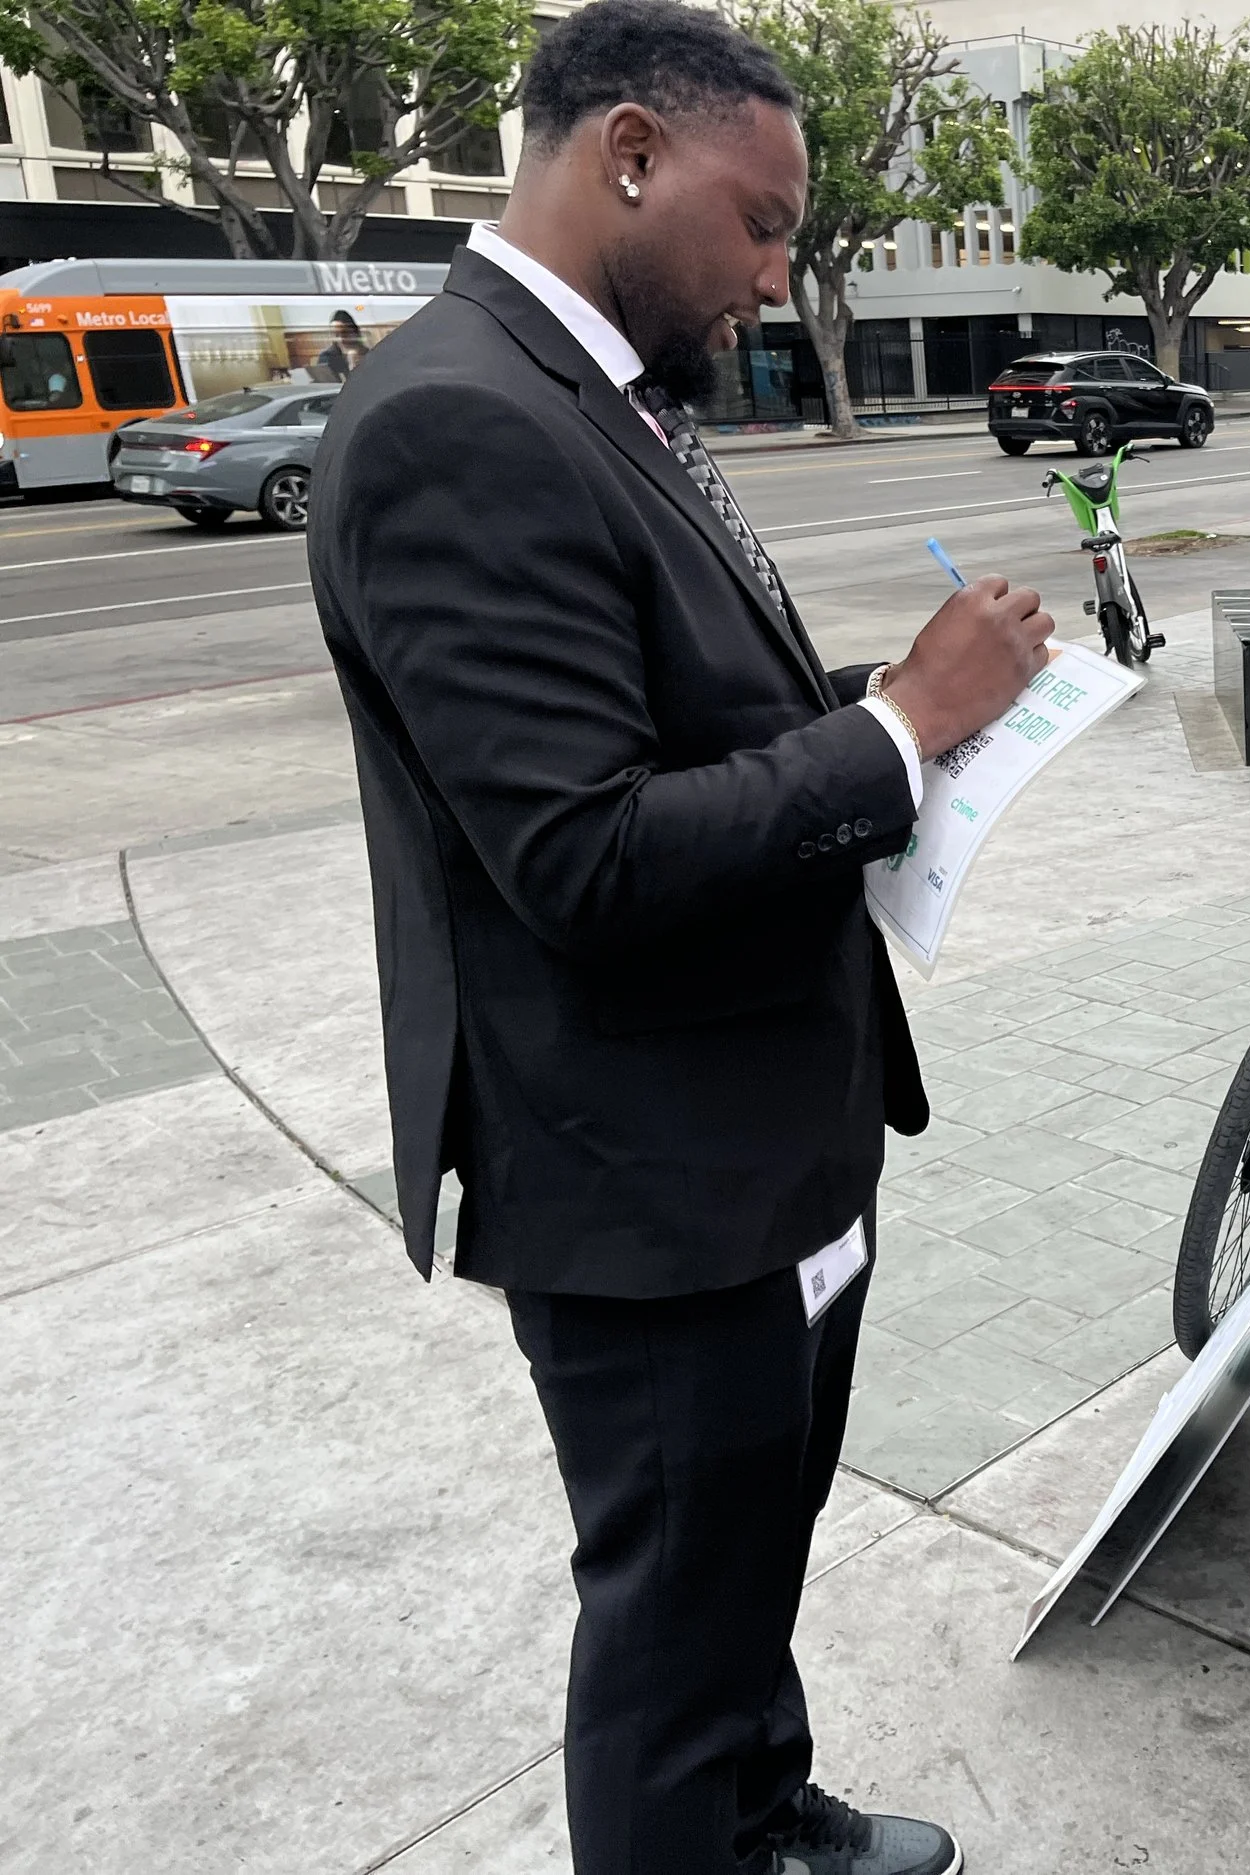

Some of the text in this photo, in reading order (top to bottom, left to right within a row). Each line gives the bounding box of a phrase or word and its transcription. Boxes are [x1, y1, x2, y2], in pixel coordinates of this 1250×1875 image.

[318, 262, 418, 293] Metro
[75, 310, 170, 327] Metro Local
[1042, 680, 1088, 712] FREE
[1004, 707, 1060, 746] CARD!!
[951, 797, 978, 822] chime
[927, 867, 944, 893] VISA
